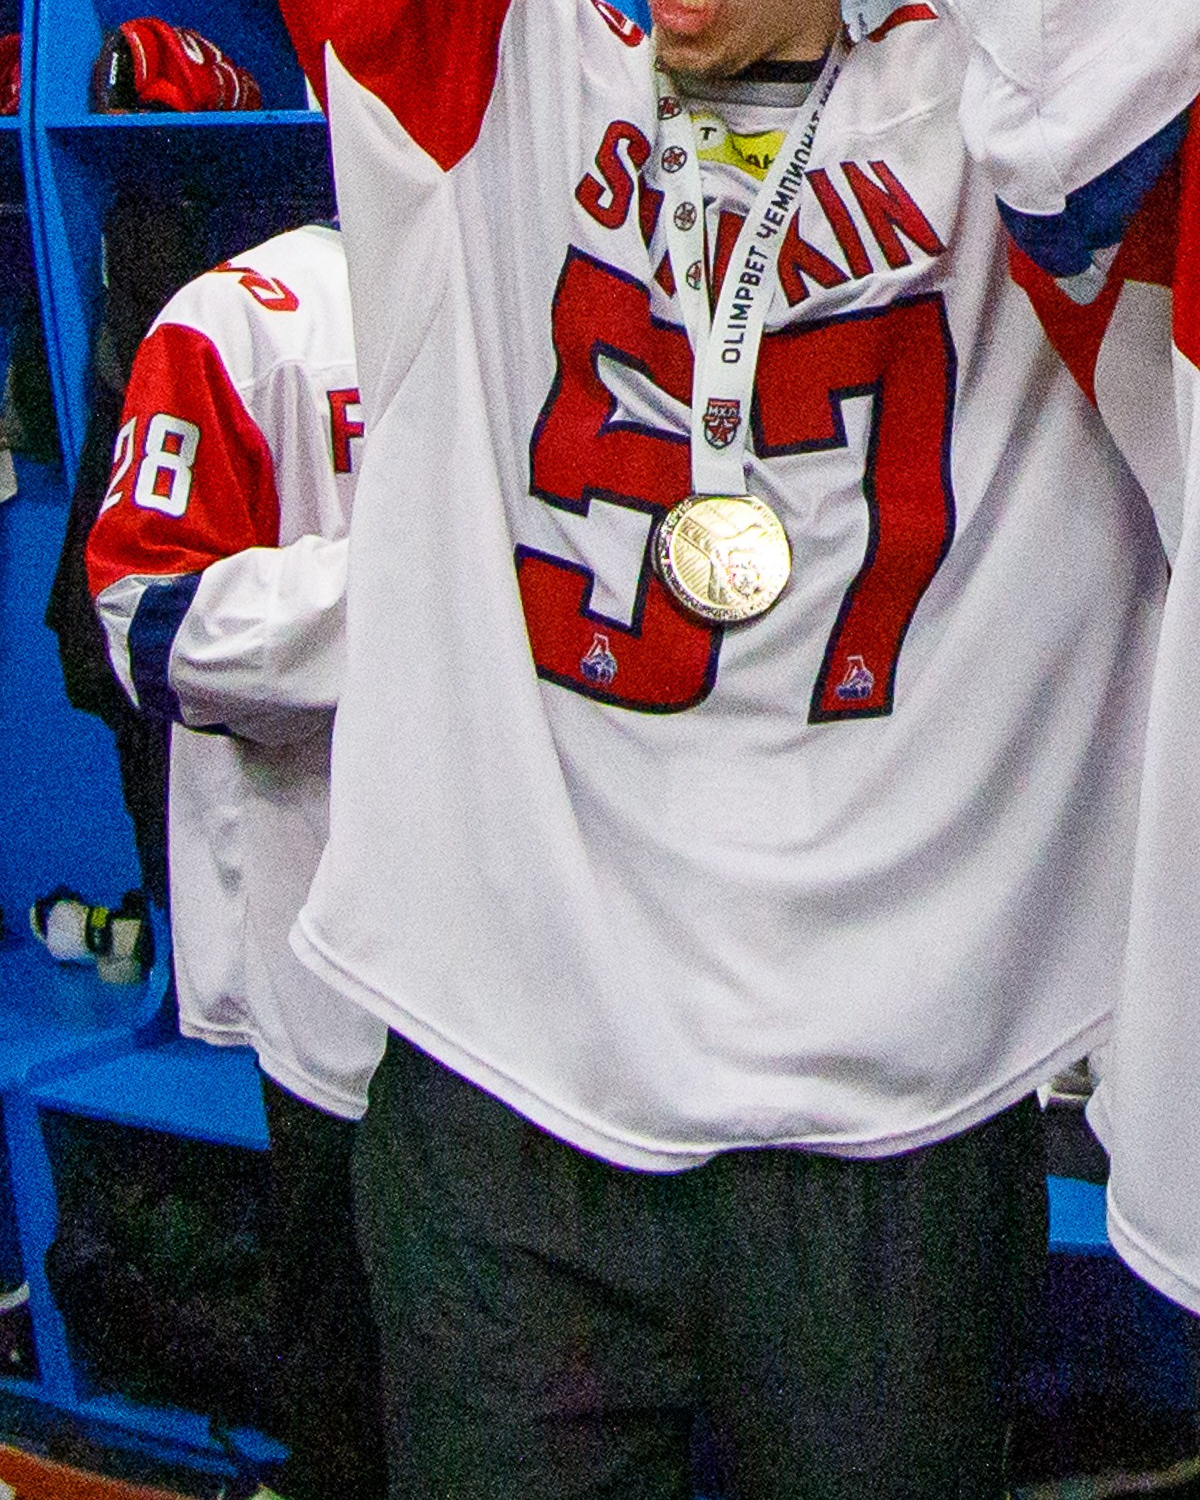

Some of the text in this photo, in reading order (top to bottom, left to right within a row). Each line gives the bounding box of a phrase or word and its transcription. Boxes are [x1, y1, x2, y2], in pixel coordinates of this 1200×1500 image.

[721, 244, 768, 364] OLIMPBET
[100, 412, 201, 519] 28
[513, 243, 959, 725] 57
